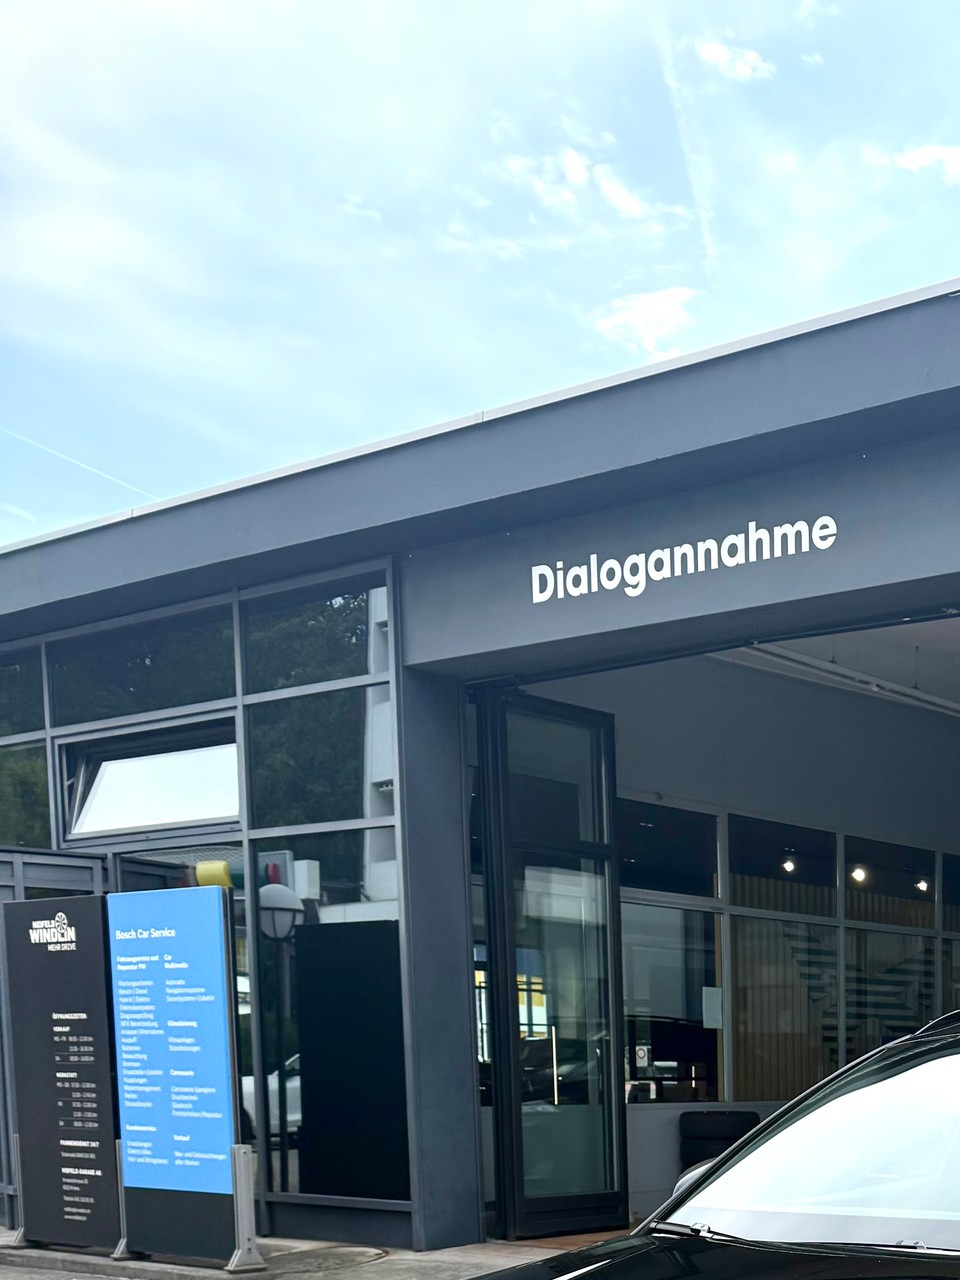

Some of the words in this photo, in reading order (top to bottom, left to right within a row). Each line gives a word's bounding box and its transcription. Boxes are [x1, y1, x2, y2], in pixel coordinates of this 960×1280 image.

[531, 515, 838, 604] Dialogannahme
[116, 929, 136, 939] Bosch
[137, 929, 149, 938] Car
[150, 927, 176, 938] Service
